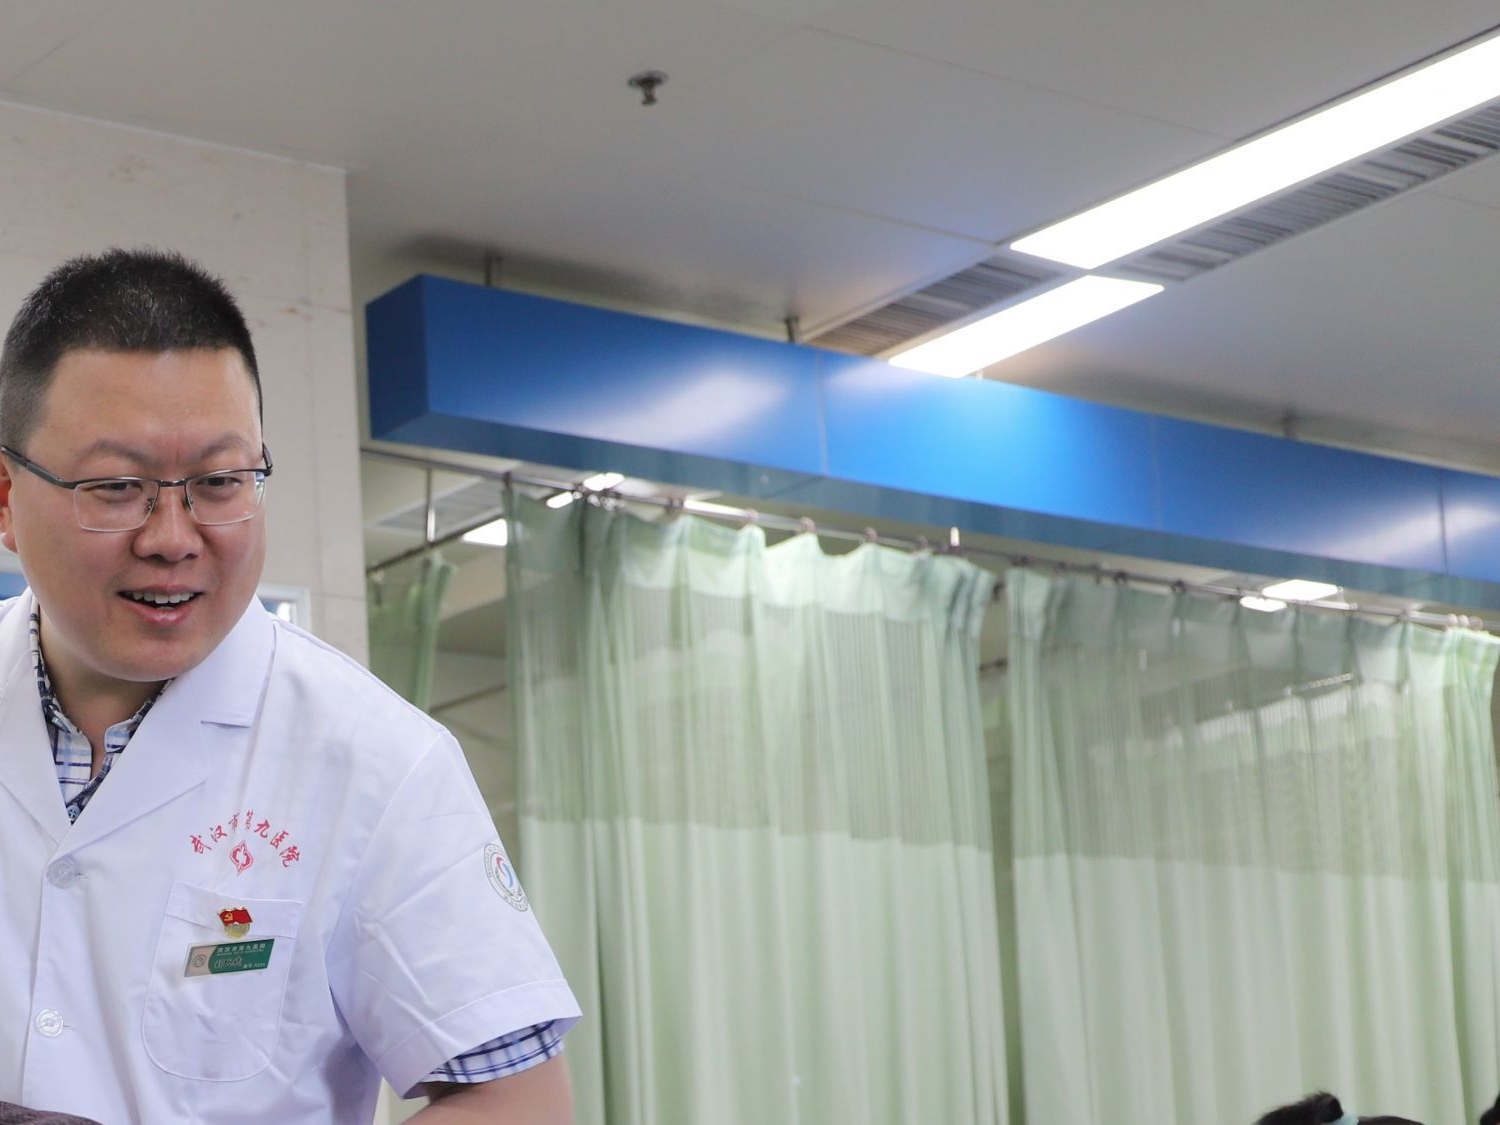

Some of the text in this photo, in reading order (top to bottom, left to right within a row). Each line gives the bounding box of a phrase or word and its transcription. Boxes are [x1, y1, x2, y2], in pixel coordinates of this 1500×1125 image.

[189, 809, 301, 868] 武汉市第九医院
